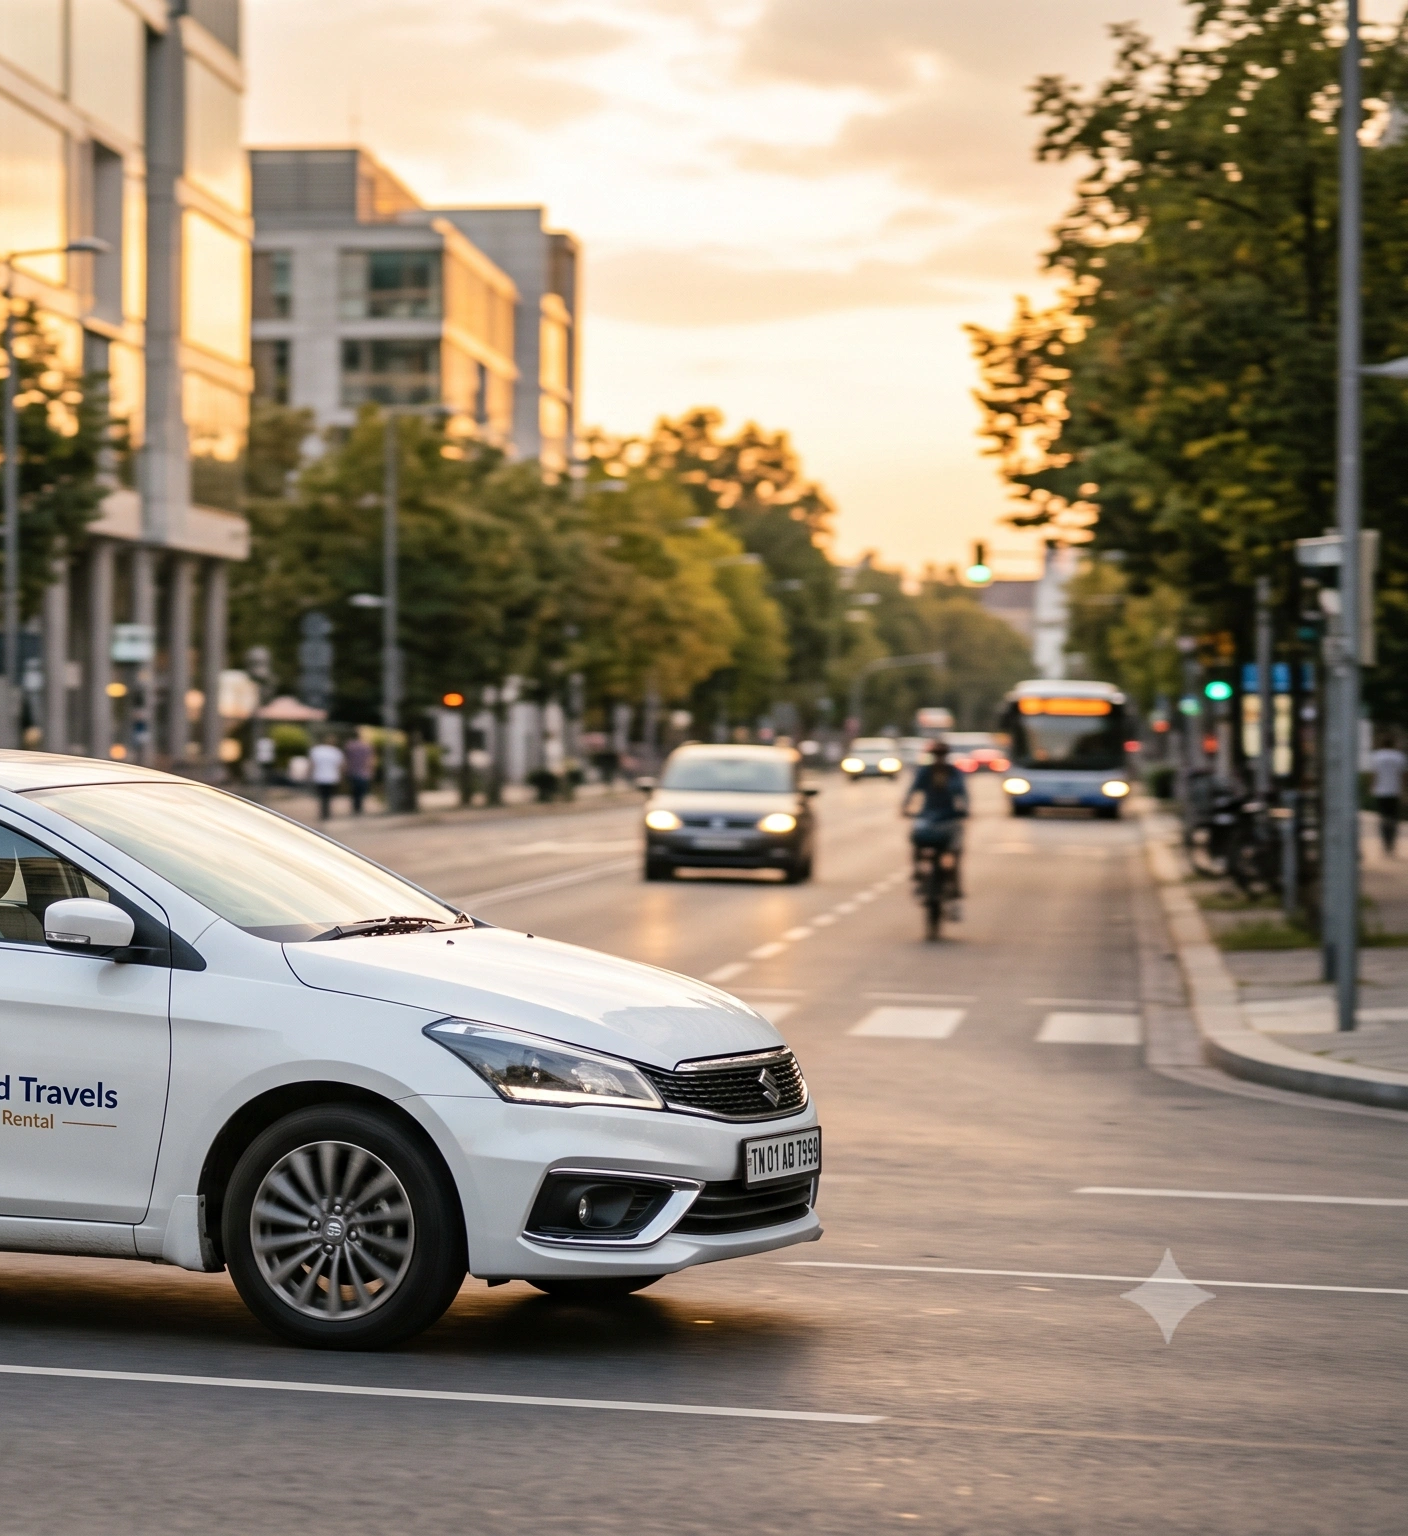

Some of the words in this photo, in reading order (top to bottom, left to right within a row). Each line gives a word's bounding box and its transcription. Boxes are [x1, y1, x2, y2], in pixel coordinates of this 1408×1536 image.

[18, 1076, 118, 1109] Travels
[2, 1110, 54, 1129] Rental
[751, 1147, 765, 1175] TN
[767, 1144, 779, 1172] 01
[782, 1142, 795, 1169] AB
